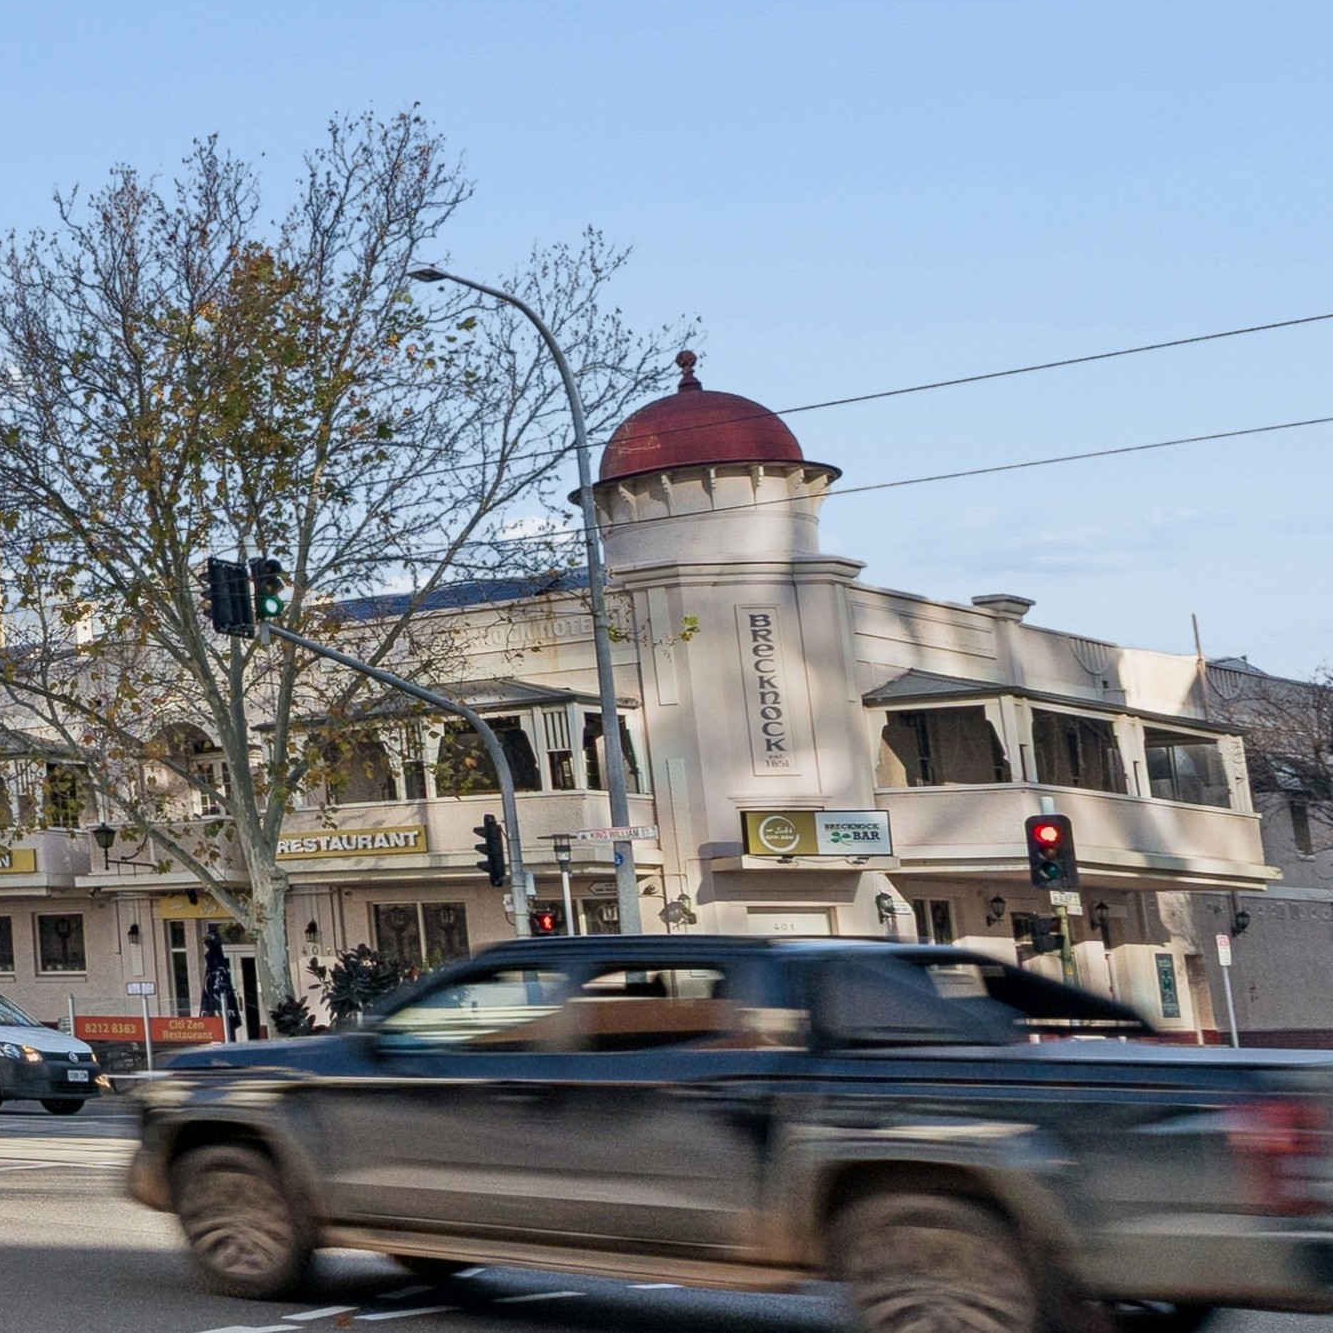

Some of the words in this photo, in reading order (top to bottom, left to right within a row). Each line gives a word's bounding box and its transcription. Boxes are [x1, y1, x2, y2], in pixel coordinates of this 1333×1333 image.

[538, 617, 593, 639] HOTE
[748, 613, 787, 752] BRECKNOCK
[824, 823, 880, 831] BRECKNOCK
[853, 831, 881, 840] BAR
[276, 831, 419, 855] RESTAURANT
[84, 1023, 110, 1034] 8212
[111, 1023, 136, 1034] 8383
[187, 1020, 204, 1029] Zen
[162, 1029, 213, 1040] Restaurant
